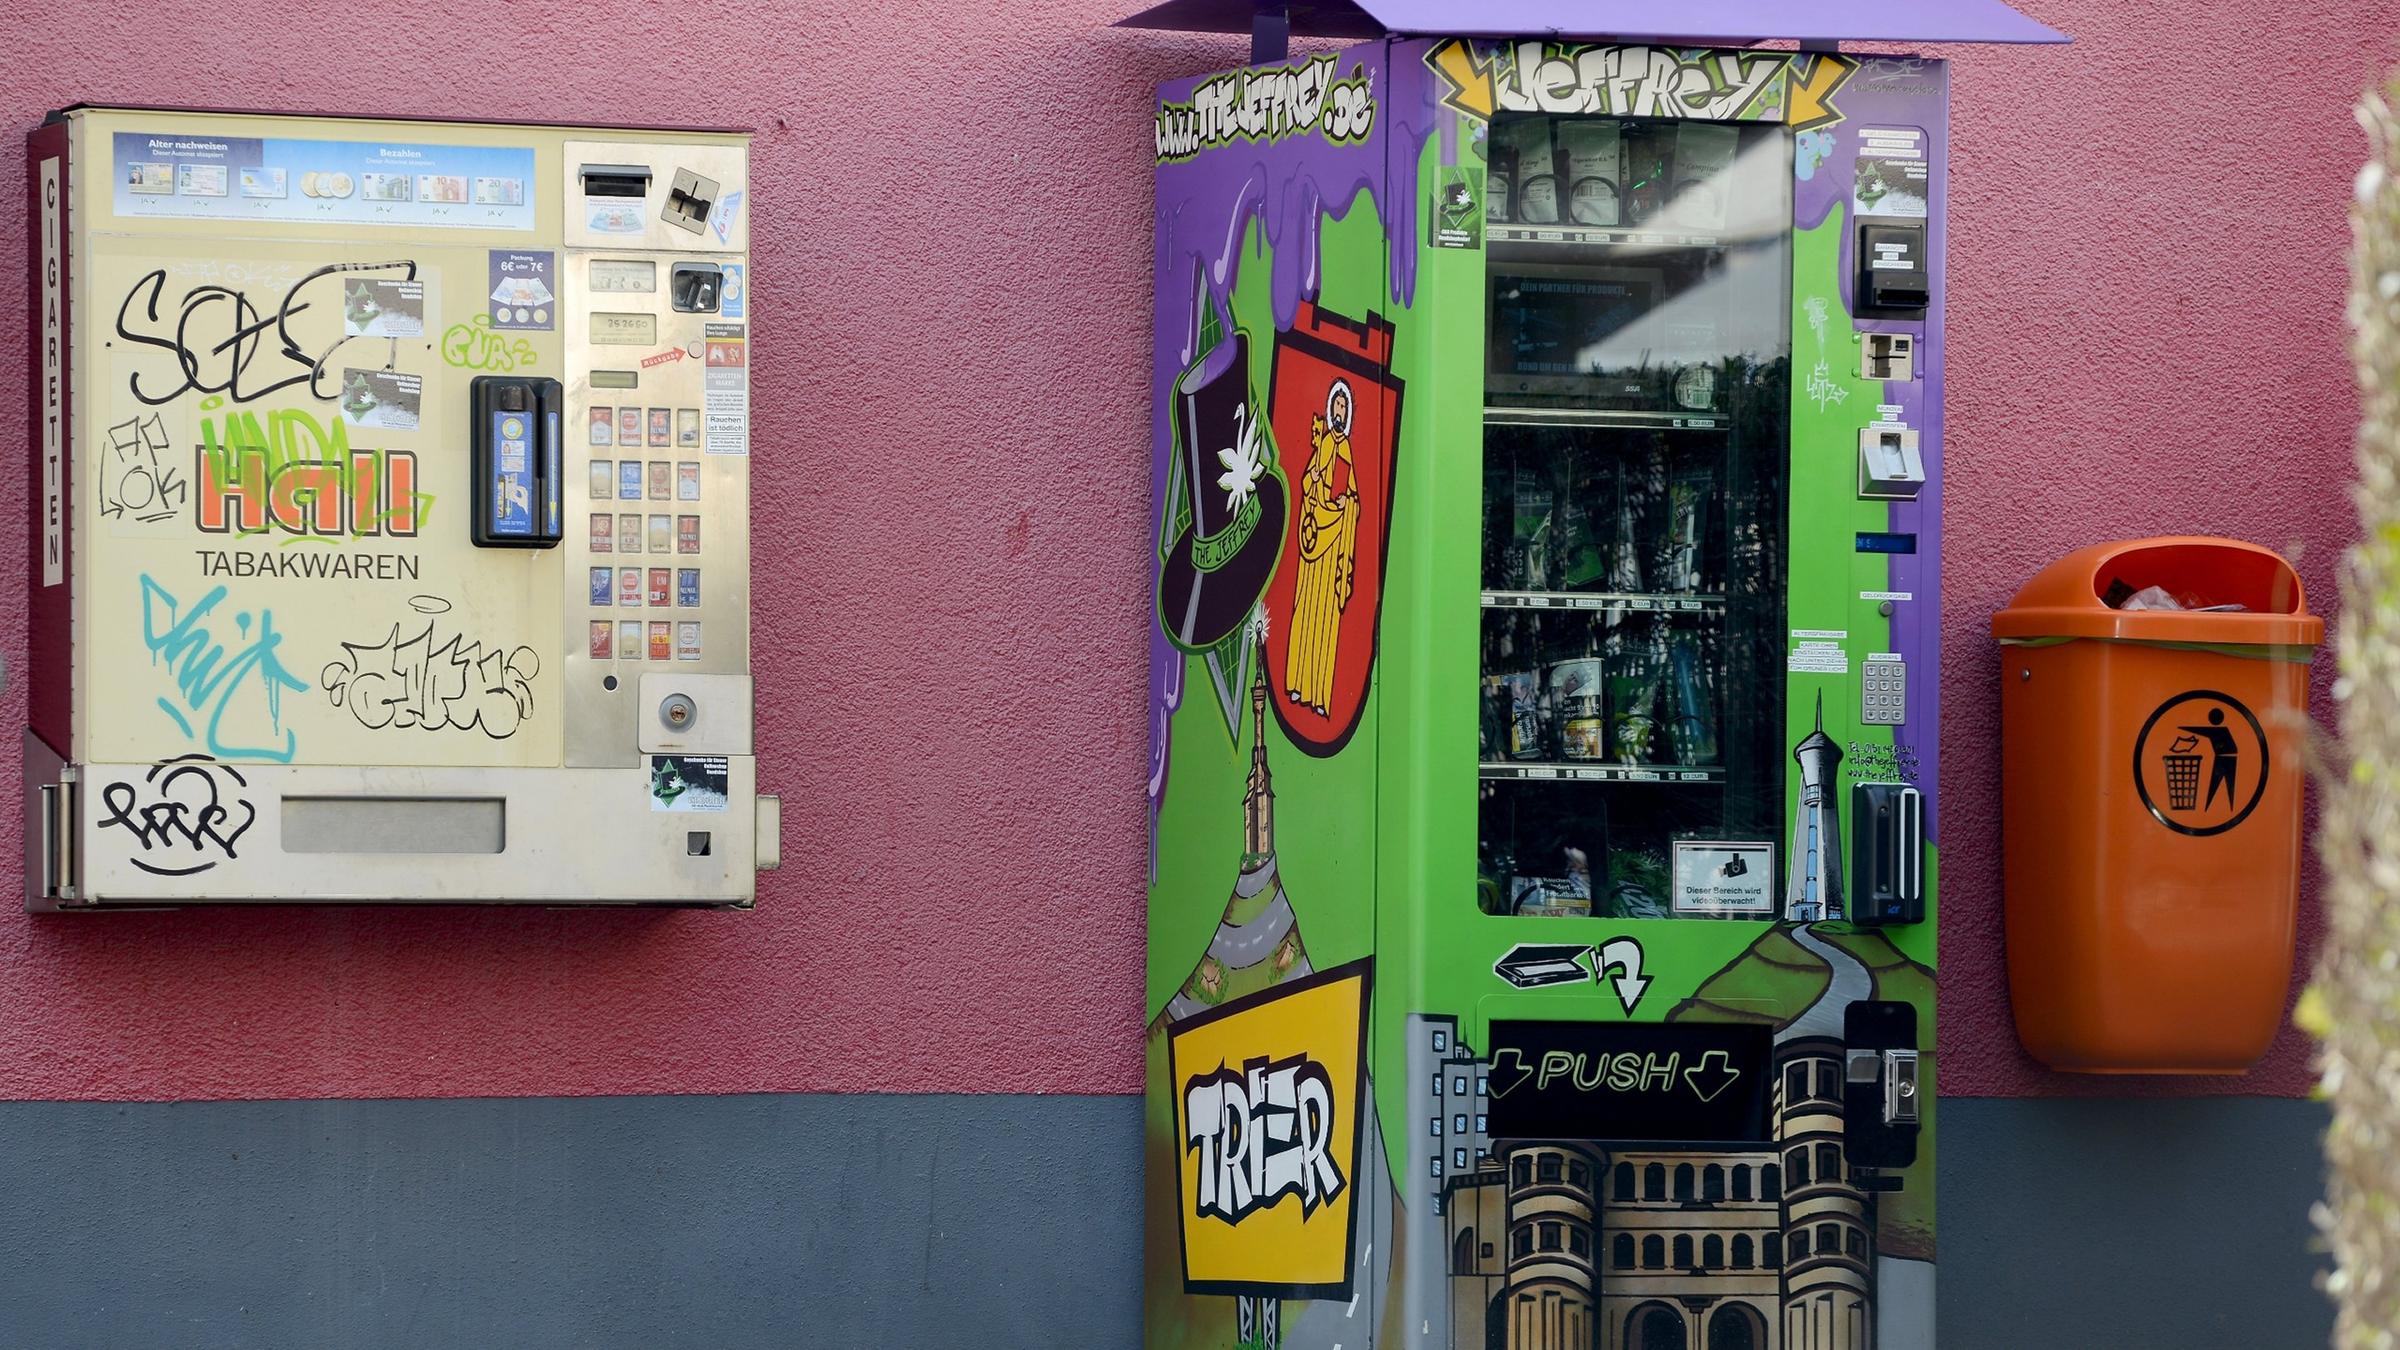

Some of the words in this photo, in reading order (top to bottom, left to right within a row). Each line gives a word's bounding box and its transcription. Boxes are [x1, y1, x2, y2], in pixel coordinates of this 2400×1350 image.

[149, 139, 173, 149] Alter
[175, 140, 228, 151] nachweisen
[380, 148, 421, 159] Bezahlen
[437, 176, 447, 186] 10
[489, 179, 501, 189] 20
[500, 261, 515, 272] 6€
[530, 262, 543, 272] 7€
[46, 177, 58, 566] CIGARETTEN
[710, 416, 741, 424] Rauchen
[720, 424, 743, 432] tödlich
[1195, 535, 1211, 564] THE
[1215, 502, 1256, 562] JEFFREY
[196, 551, 419, 580] TABAKWAREN
[1686, 886, 1711, 894] Dieser
[1713, 886, 1743, 895] Bereich
[1744, 887, 1762, 895] wird
[1691, 896, 1756, 905] videoüberwacht!
[1537, 1051, 1680, 1091] PUSH
[1186, 1057, 1343, 1222] TRIER
